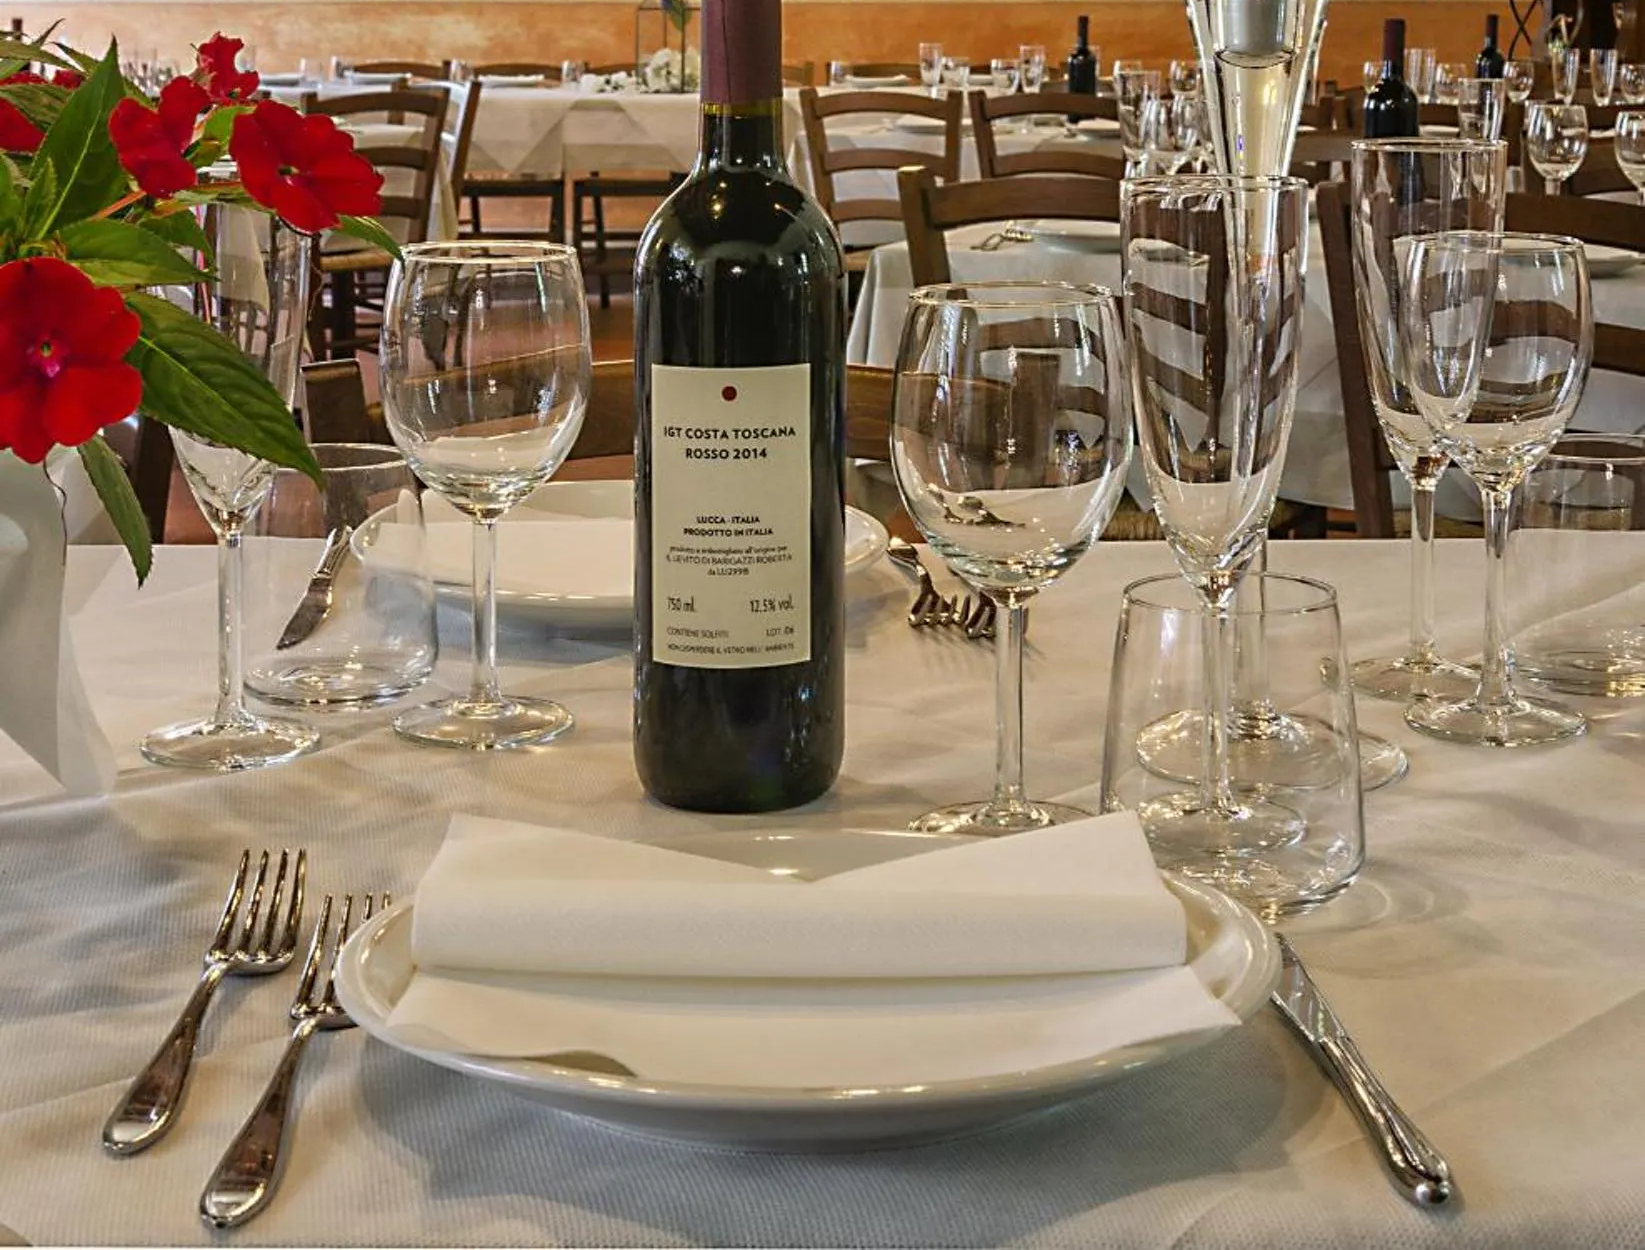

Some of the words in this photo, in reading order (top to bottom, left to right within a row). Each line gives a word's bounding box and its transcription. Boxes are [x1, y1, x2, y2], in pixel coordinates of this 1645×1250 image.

[664, 426, 682, 437] IGT
[685, 427, 729, 440] COSTA
[732, 426, 796, 439] TOSCANA
[685, 448, 730, 460] ROSSO
[733, 448, 768, 460] 2014
[696, 516, 726, 524] LUCCA
[731, 516, 760, 524] ITALIA
[683, 528, 732, 537] PRODOTTO
[734, 529, 744, 537] IN
[745, 528, 773, 536] ITALIA
[667, 597, 682, 611] 750
